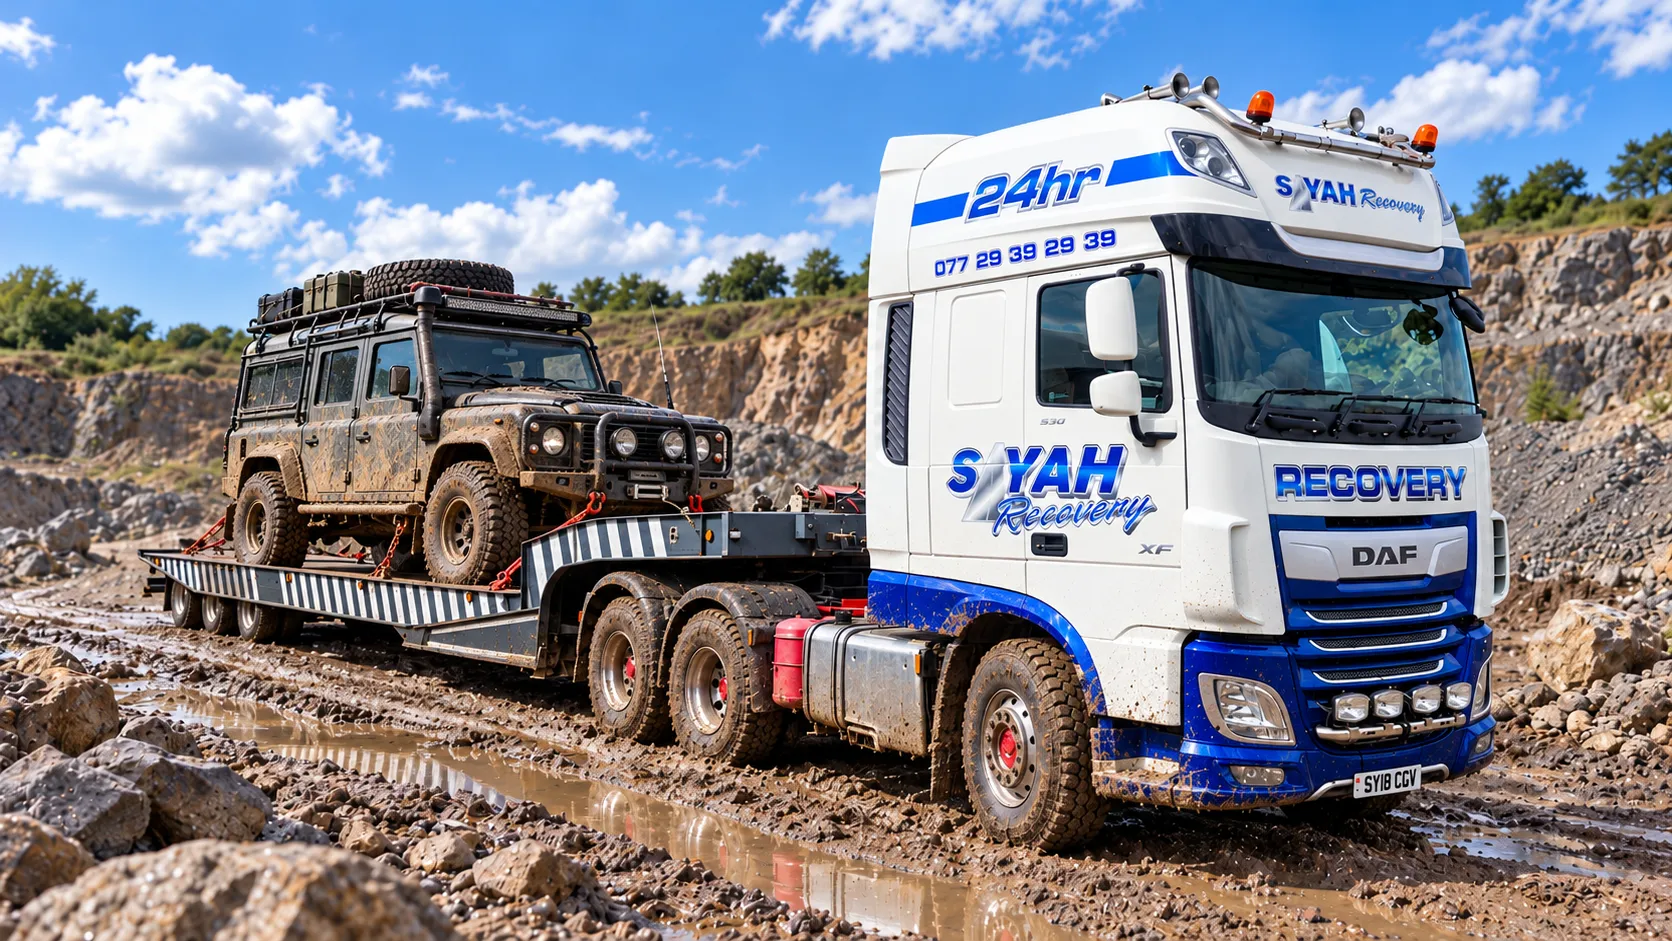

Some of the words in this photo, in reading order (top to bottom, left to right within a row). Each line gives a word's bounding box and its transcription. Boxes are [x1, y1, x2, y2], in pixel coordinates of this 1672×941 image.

[965, 160, 1104, 223] 24hr
[1360, 188, 1425, 222] Recovery
[934, 254, 969, 277] 077
[975, 249, 1002, 270] 29
[1009, 243, 1037, 264] 39
[1044, 236, 1075, 258] 29
[1083, 228, 1116, 251] 39
[1273, 464, 1467, 502] RECOVERY
[991, 494, 1158, 537] Recovery
[1138, 543, 1174, 555] XF
[1352, 545, 1417, 566] DAF
[1364, 773, 1391, 793] SY18
[1394, 768, 1417, 789] CGV
